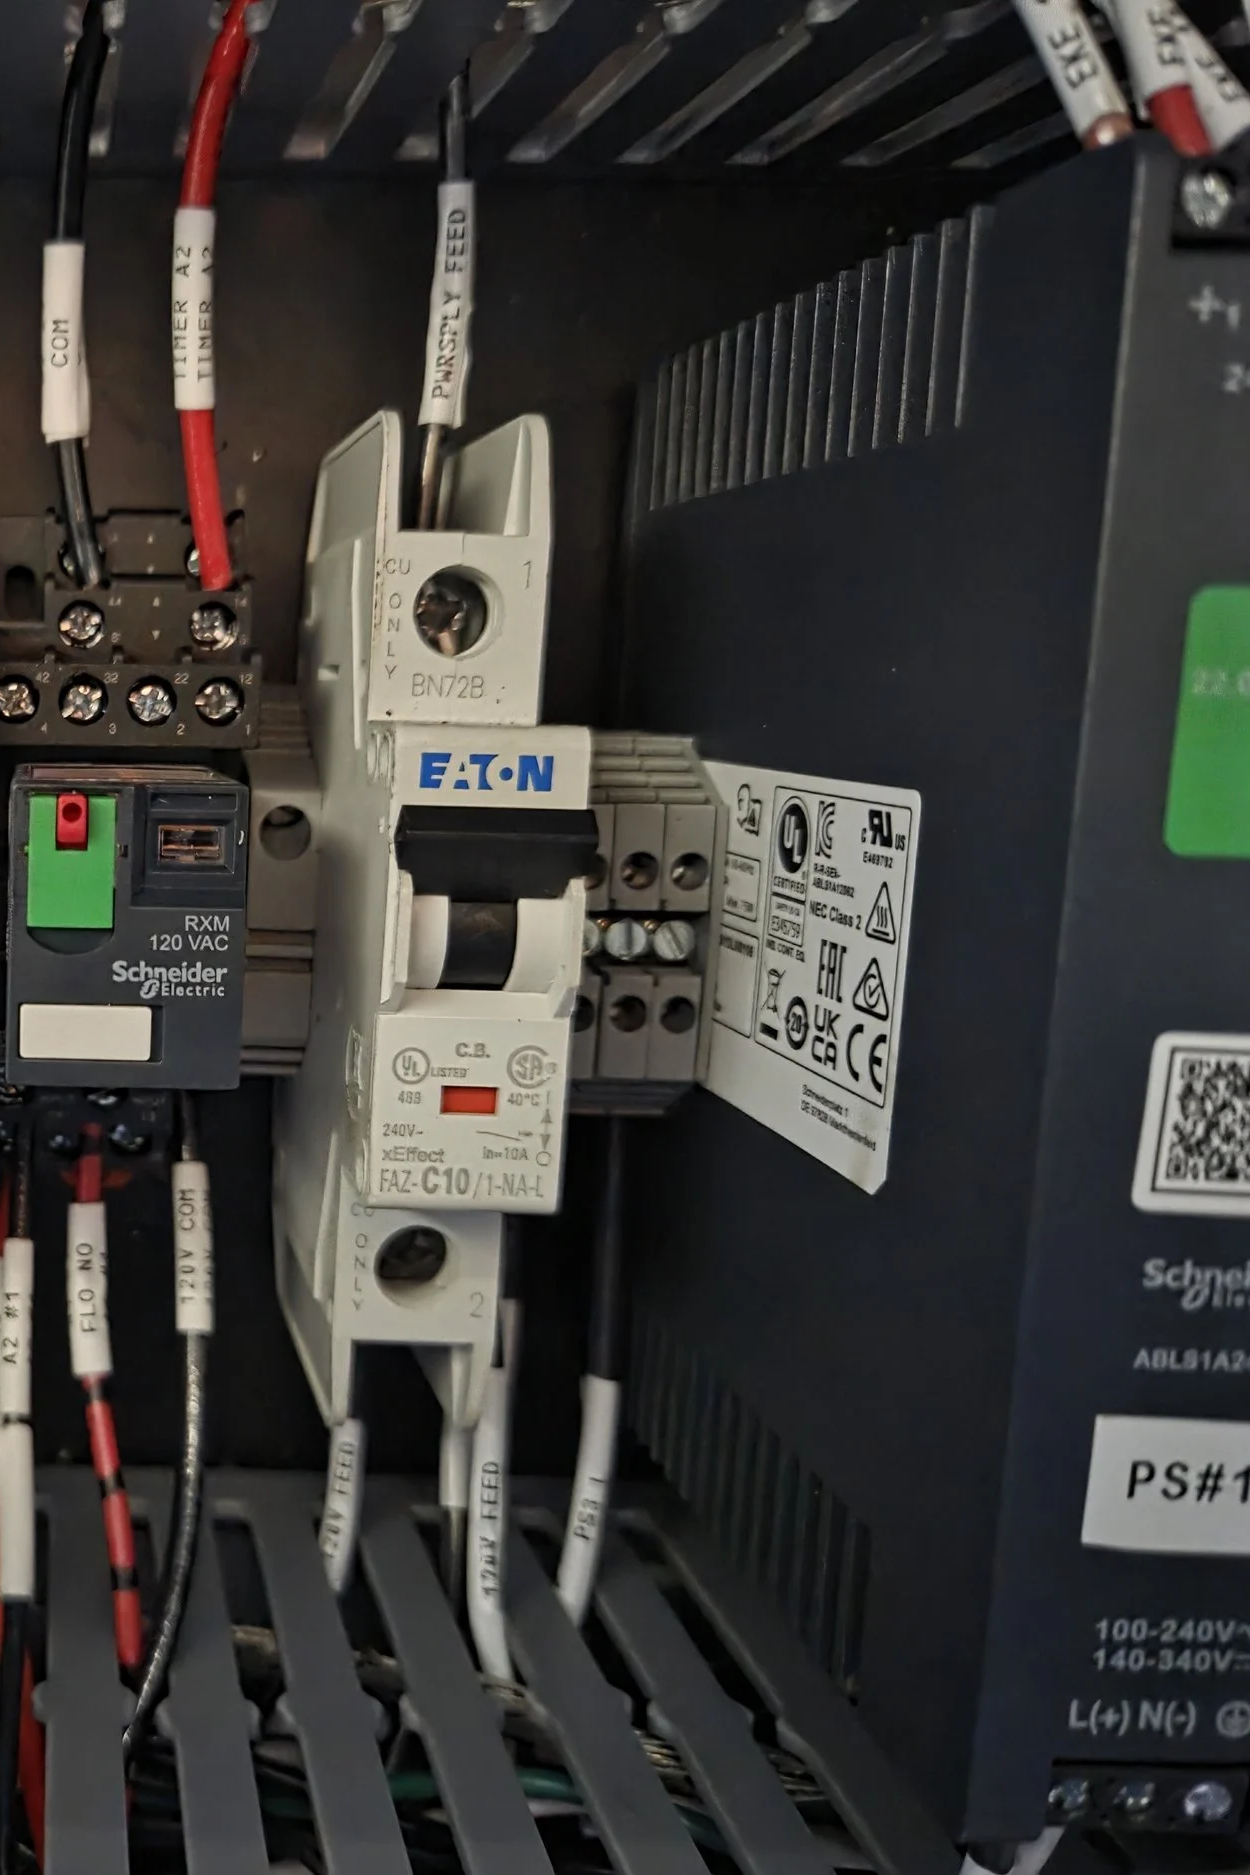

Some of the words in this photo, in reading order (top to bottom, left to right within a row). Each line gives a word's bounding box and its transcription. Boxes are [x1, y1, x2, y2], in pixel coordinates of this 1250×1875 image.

[444, 209, 466, 273] FEED
[175, 246, 191, 278] A2
[51, 319, 69, 368] COM
[173, 300, 188, 379] TIMER
[197, 300, 212, 383] TIMER
[431, 290, 461, 399] PWRSPLY
[385, 558, 411, 575] CU
[522, 560, 532, 590] 1
[35, 672, 51, 684] 42
[103, 672, 119, 684] 32
[173, 672, 190, 685] 22
[239, 673, 254, 685] 12
[411, 673, 485, 699] BN72B
[40, 722, 48, 734] 4
[108, 723, 117, 735] 3
[176, 723, 186, 736] 2
[419, 752, 554, 792] EATON
[774, 875, 806, 895] CERTIFIED
[185, 915, 230, 932] RXM
[809, 900, 828, 919] NEC
[829, 905, 854, 927] Class
[855, 914, 862, 930] 2
[150, 934, 183, 951] 120
[188, 934, 229, 951] VAC
[112, 960, 228, 983] Schneider
[161, 983, 225, 997] Electric
[814, 1004, 841, 1040] UK
[455, 1042, 491, 1058] C.B.
[811, 1035, 837, 1071] CA
[846, 1024, 887, 1093] CE
[381, 1146, 445, 1163] xEffect
[379, 1165, 544, 1199] FAZ-C10/1-NA-L
[178, 1188, 195, 1231] COM
[76, 1242, 93, 1270] NO
[179, 1250, 195, 1303] 120V
[4, 1291, 19, 1319] #1
[78, 1288, 96, 1333] FLO
[469, 1291, 484, 1318] 2
[2, 1336, 19, 1364] A2
[334, 1441, 355, 1495] FEED
[1127, 1459, 1250, 1504] PS#1
[480, 1461, 500, 1520] FEED
[1068, 1699, 1130, 1737] L(+)
[1139, 1700, 1196, 1738] N(-)
